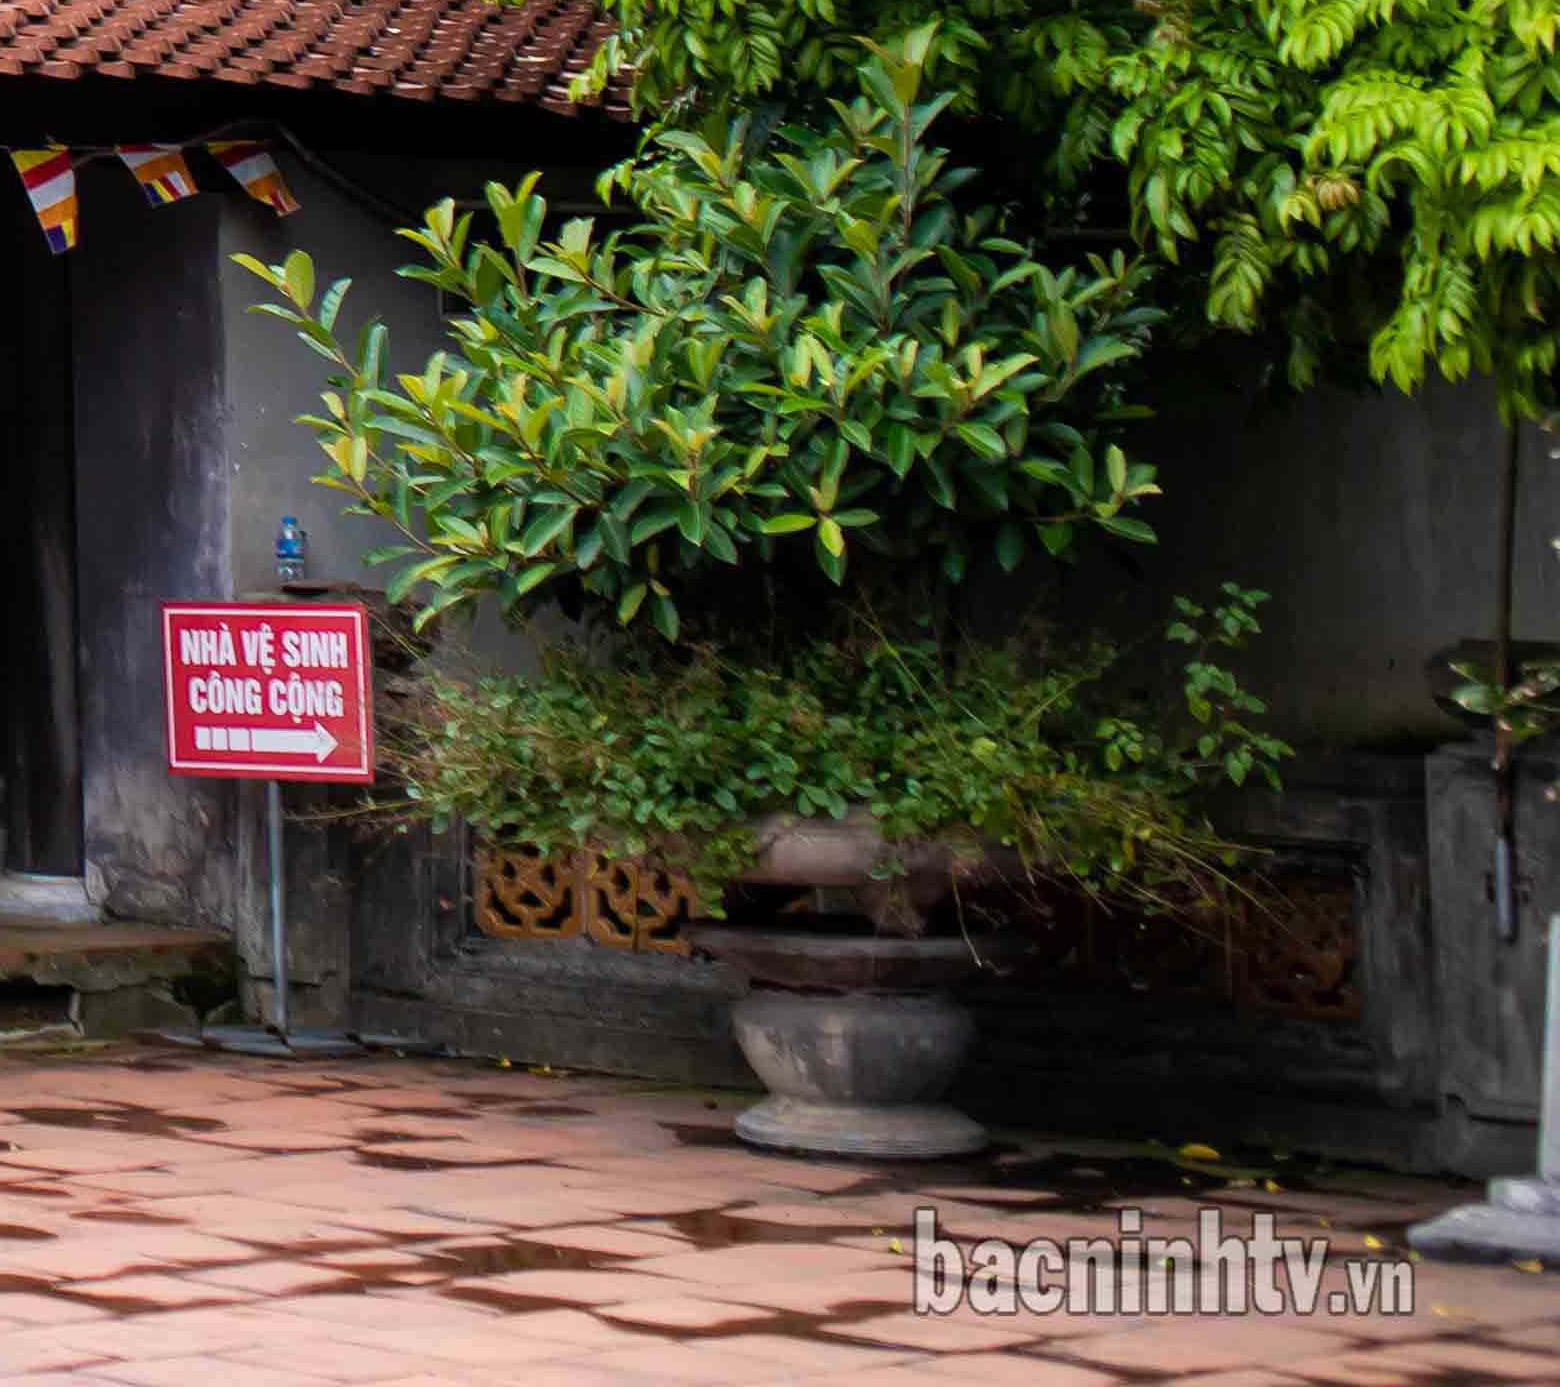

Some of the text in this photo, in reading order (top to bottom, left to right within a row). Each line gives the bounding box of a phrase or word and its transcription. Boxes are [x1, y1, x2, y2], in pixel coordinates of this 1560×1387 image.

[179, 622, 349, 674] NHÀ VỆ SINH
[188, 671, 345, 724] CÔNG CỘNG
